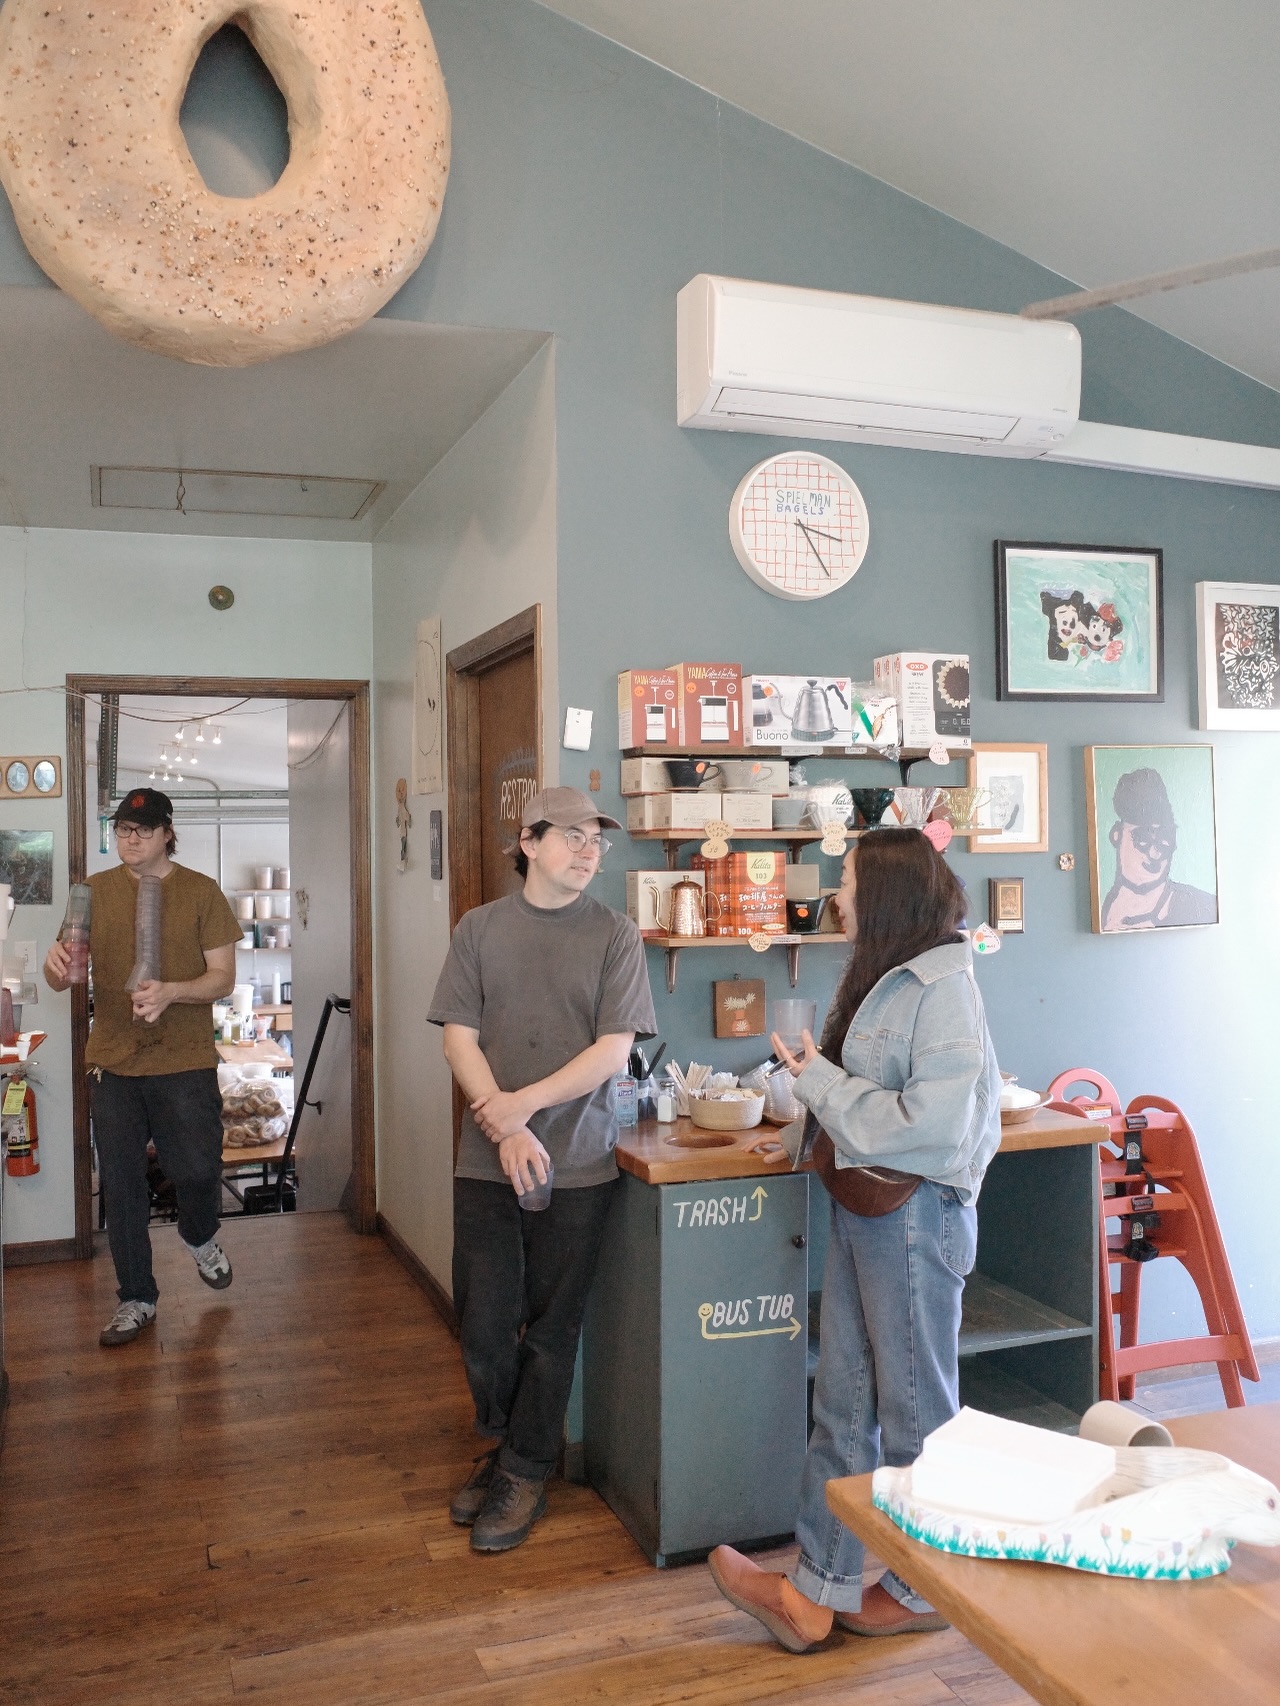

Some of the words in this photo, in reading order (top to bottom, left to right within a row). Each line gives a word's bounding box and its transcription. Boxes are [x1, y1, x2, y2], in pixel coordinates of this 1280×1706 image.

[776, 489, 831, 508] SPIELMAN
[776, 504, 824, 515] BAGELS
[687, 667, 706, 679] YAMA
[756, 729, 789, 741] Buono
[500, 777, 537, 821] RESTROO
[750, 858, 771, 870] Kalita
[737, 927, 752, 935] 100
[673, 1196, 747, 1228] TRASH
[712, 1299, 752, 1328] BUS
[756, 1293, 795, 1323] TUB
